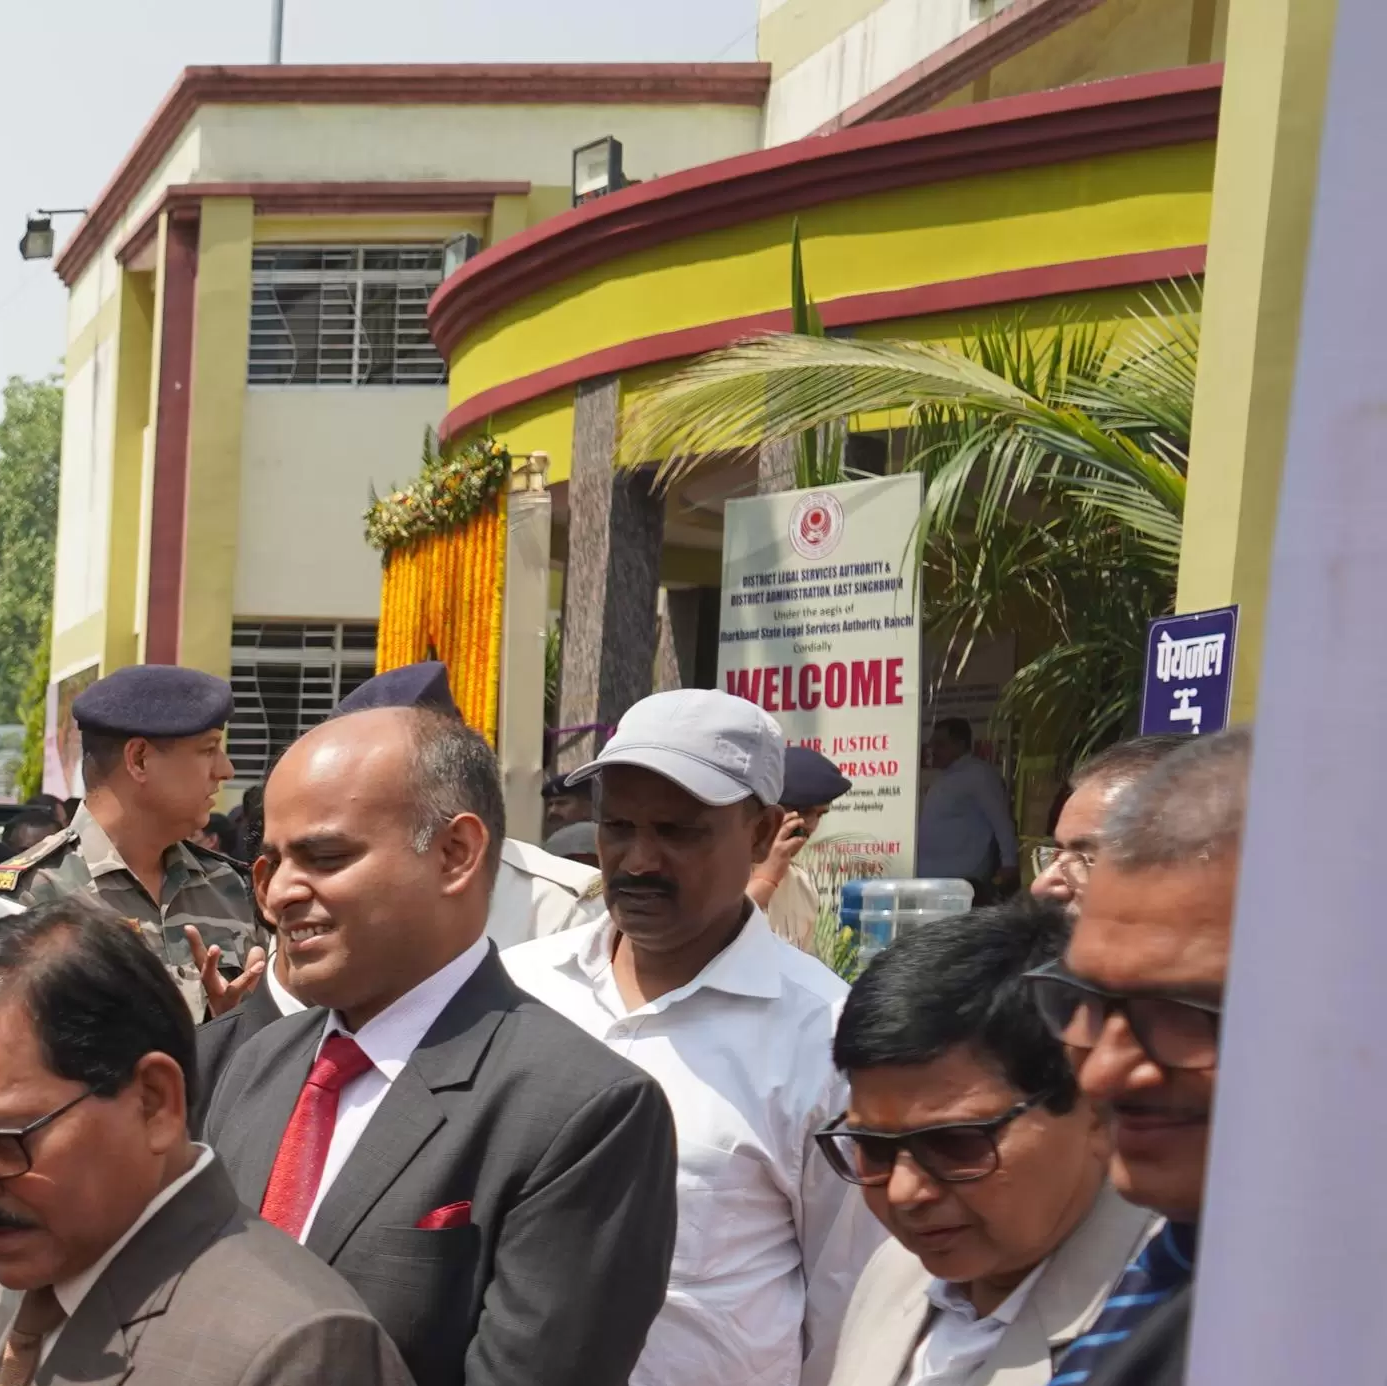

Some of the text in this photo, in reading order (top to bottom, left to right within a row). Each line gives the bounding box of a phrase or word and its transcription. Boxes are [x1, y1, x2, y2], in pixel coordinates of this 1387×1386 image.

[743, 561, 891, 588] DISTRICT LEGAL SERVICES AUTHORITY &
[731, 591, 764, 606] DISTRICT
[833, 583, 852, 597] EAST
[773, 603, 854, 620] Under the aegis of
[760, 625, 781, 639] State
[783, 623, 803, 639] Legal
[806, 620, 840, 635] Services
[884, 615, 914, 630] Ranchi
[793, 641, 832, 654] Cordially
[1156, 630, 1226, 683] पेयजल
[726, 657, 904, 713] WELCOME
[832, 735, 889, 756] JUSTICE
[839, 760, 899, 777] PRASAD
